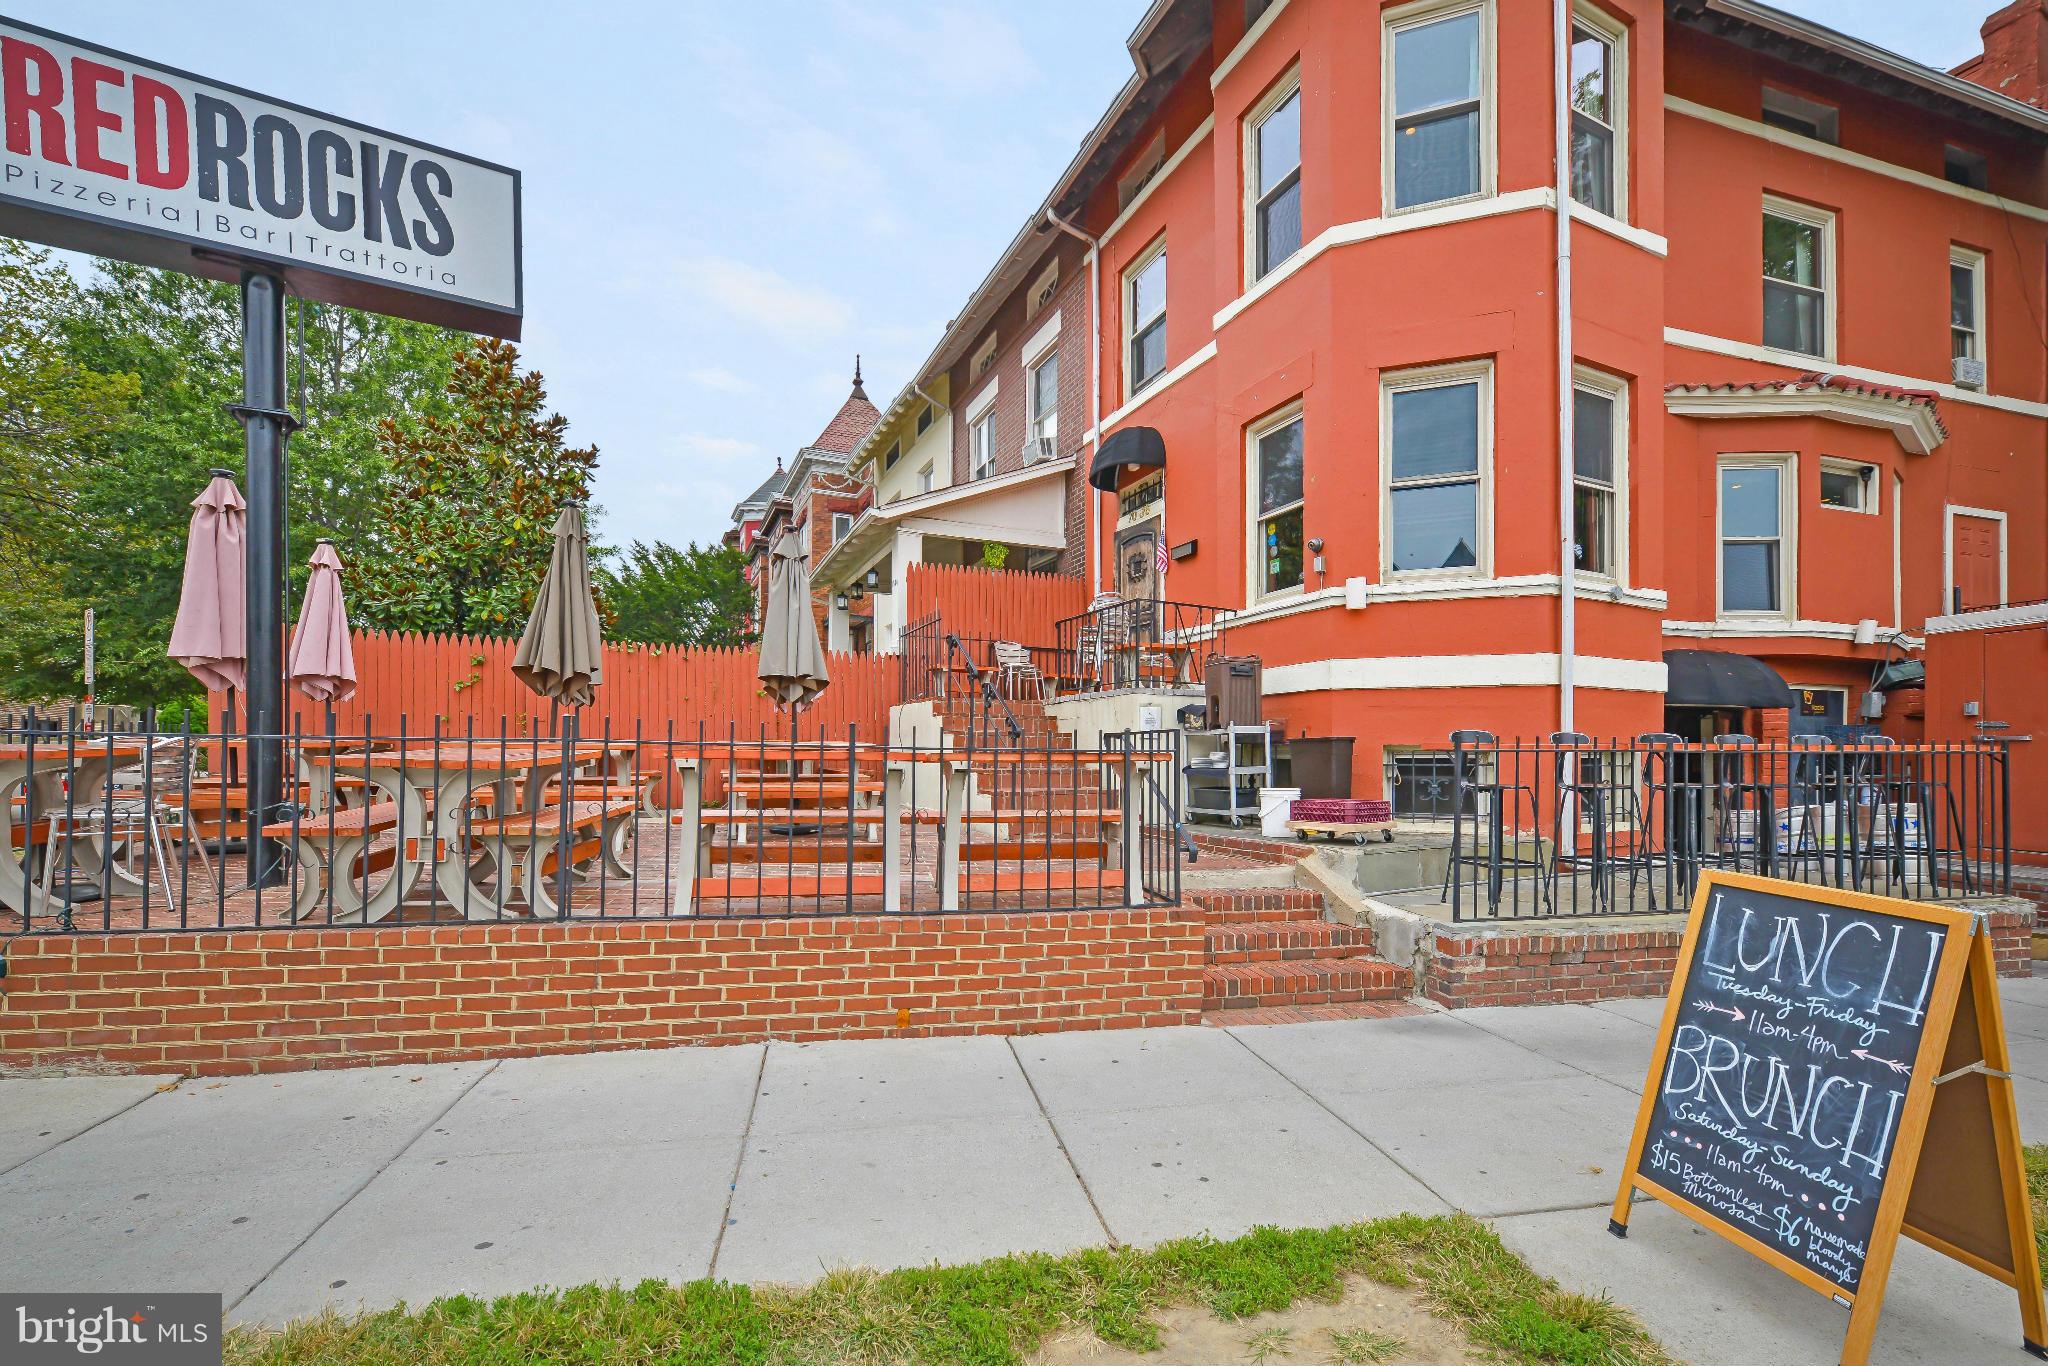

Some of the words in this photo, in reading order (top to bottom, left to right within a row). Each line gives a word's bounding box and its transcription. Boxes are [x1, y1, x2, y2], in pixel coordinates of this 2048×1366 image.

[305, 235, 457, 286] Trattoria
[1702, 893, 1945, 1026] LUNCH
[1749, 1010, 1849, 1060] 11am-4pm
[1665, 1025, 1904, 1180] BRUNCH
[1651, 1139, 1681, 1175] $15
[1682, 1162, 1776, 1222] Bottomless
[1706, 1143, 1794, 1198] 11am-4pm
[1773, 1204, 1803, 1248] $6
